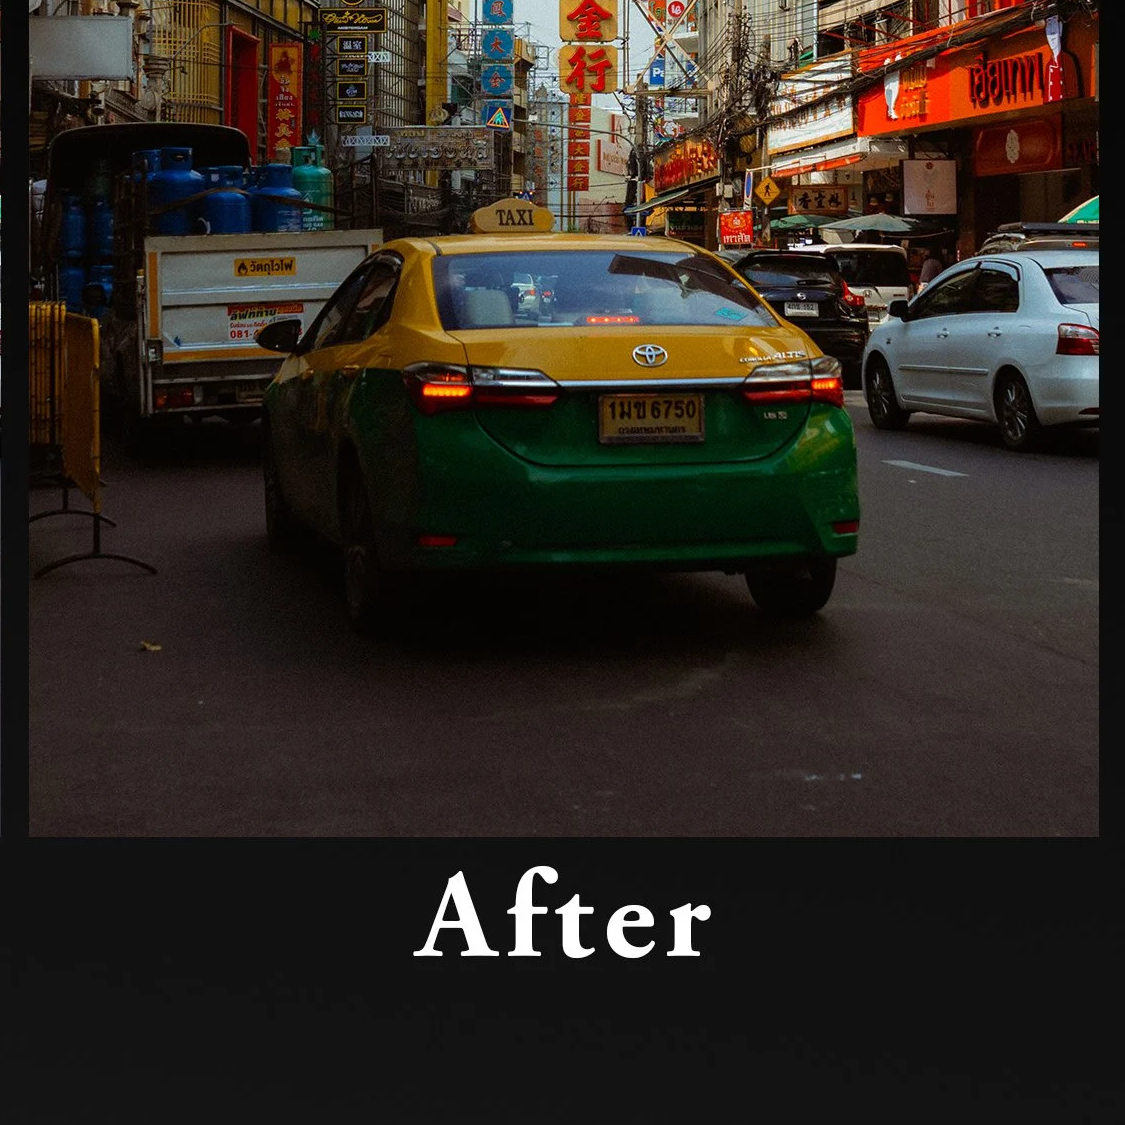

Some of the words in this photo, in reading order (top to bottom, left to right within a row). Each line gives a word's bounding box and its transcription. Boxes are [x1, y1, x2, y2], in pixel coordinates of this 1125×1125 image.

[495, 207, 534, 228] TAXI
[771, 350, 806, 360] ALTIS
[650, 400, 696, 419] 6750
